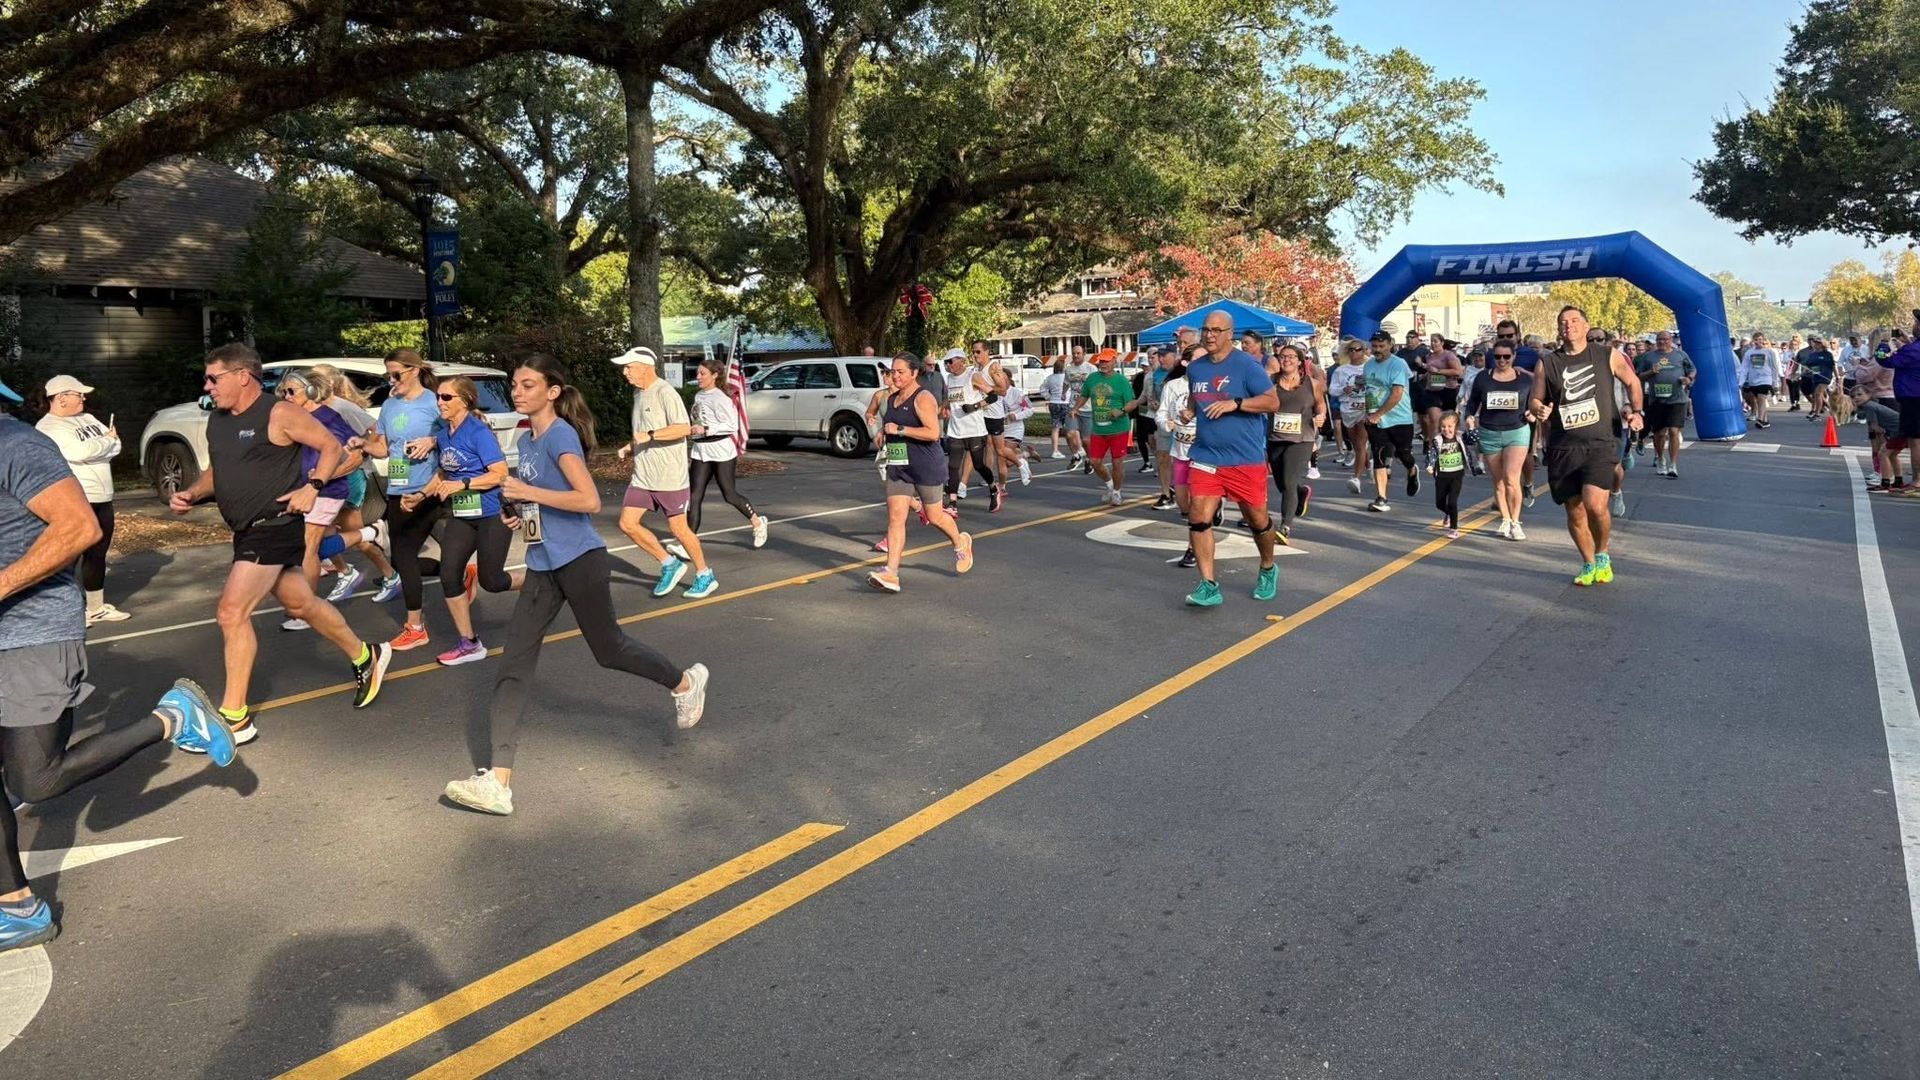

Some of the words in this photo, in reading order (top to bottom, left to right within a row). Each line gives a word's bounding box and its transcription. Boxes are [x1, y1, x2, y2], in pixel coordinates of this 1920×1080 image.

[1435, 248, 1593, 277] FINISH
[435, 294, 455, 304] FOLEY
[1192, 382, 1208, 393] LIVE
[1490, 398, 1516, 407] 4561
[1565, 410, 1596, 426] 4709
[1274, 420, 1297, 431] 4721
